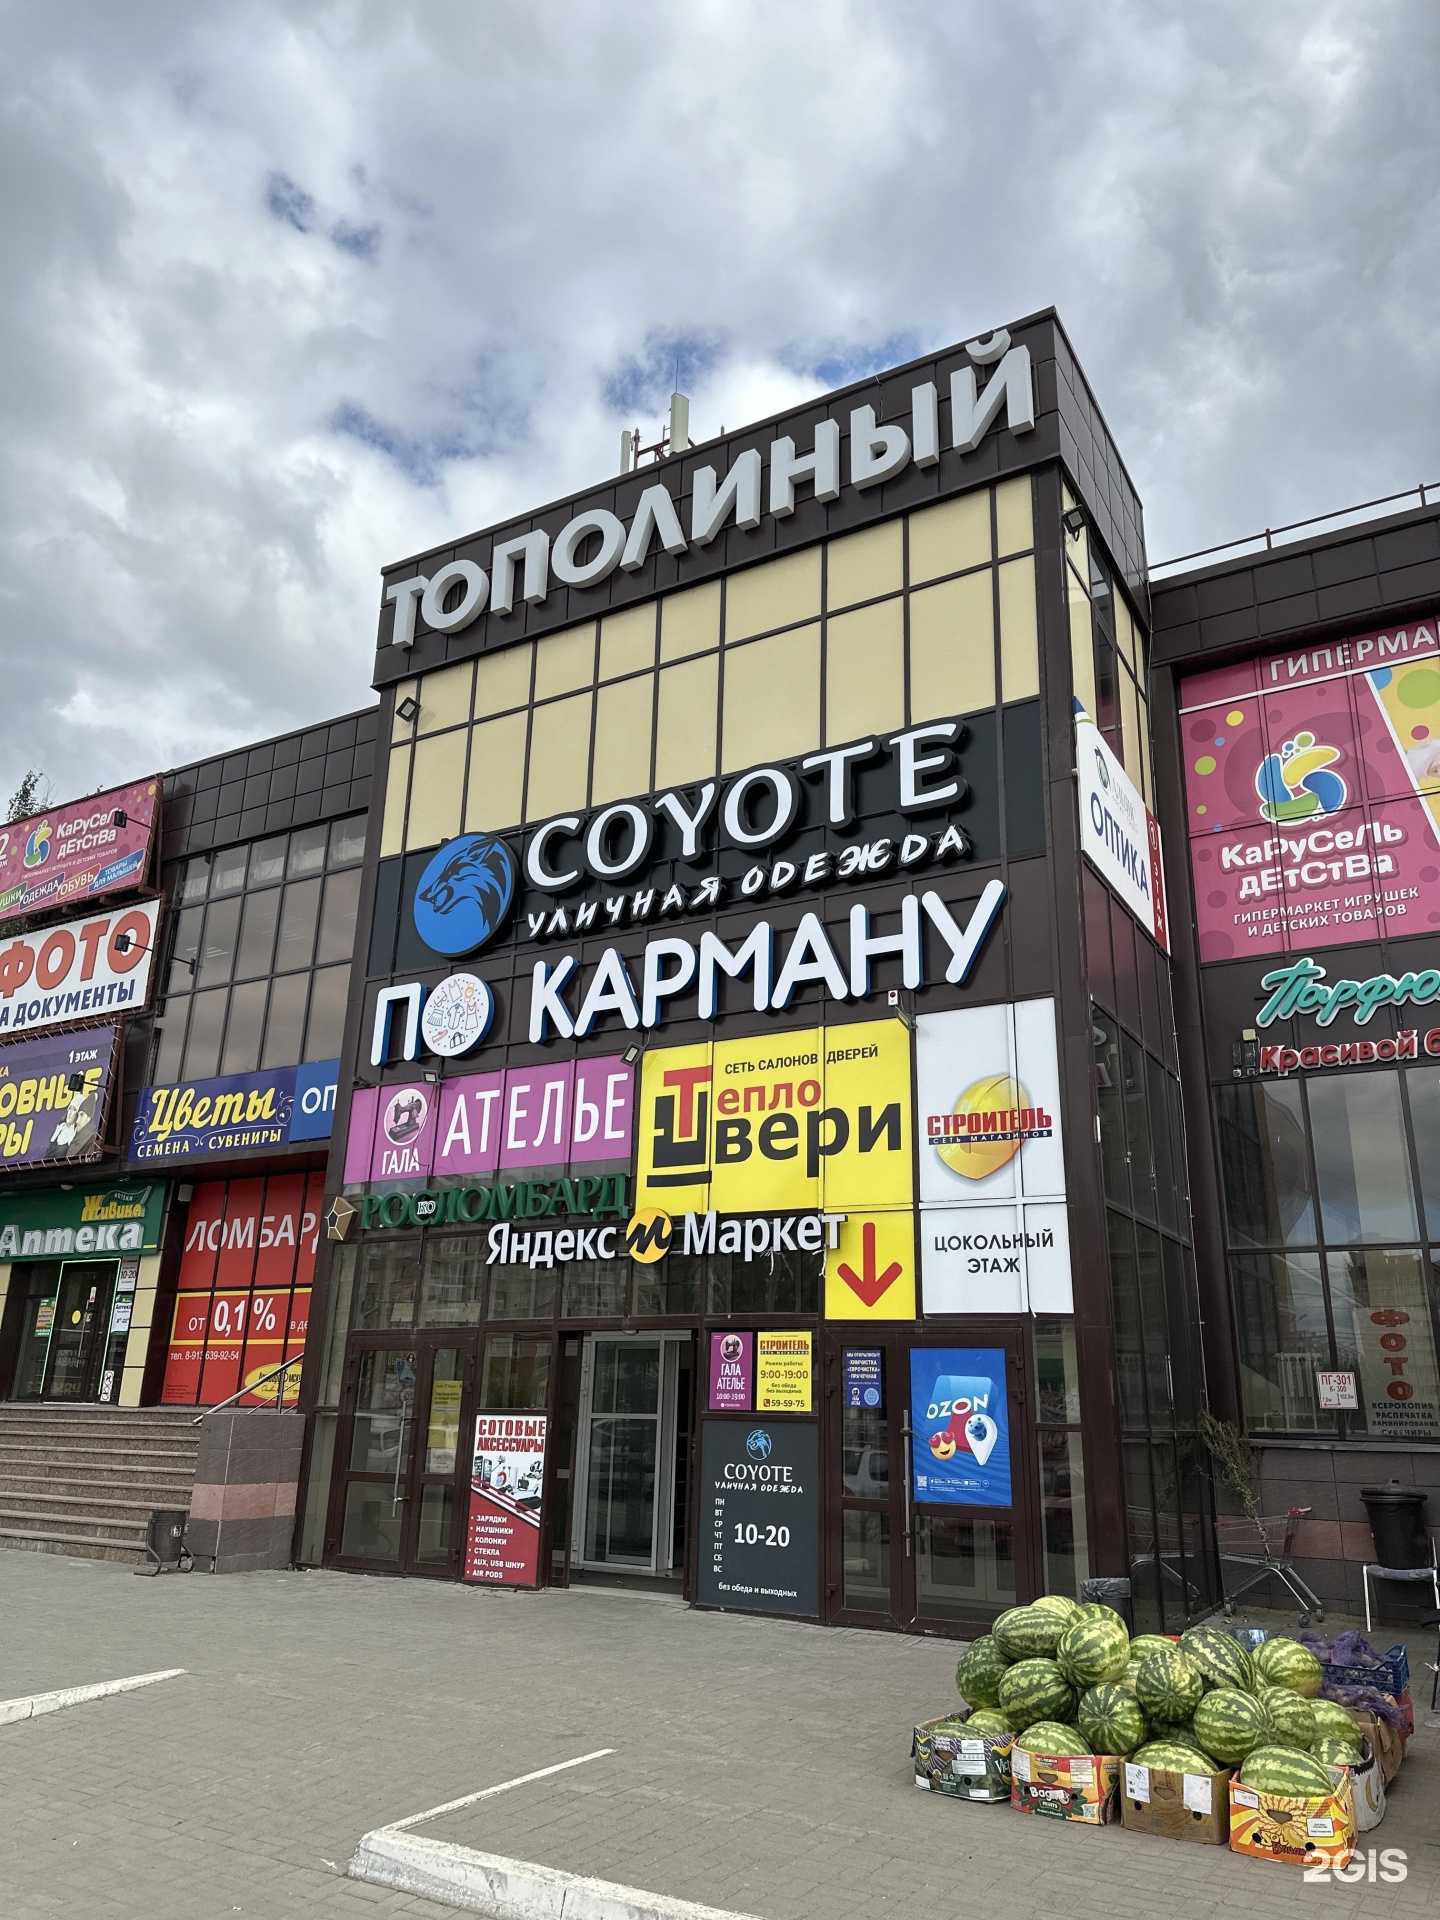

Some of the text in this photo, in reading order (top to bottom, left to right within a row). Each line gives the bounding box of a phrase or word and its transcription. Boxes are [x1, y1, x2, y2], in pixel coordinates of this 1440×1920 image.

[385, 329, 1035, 650] ТОПОЛИНЫЙ
[1270, 621, 1440, 680] ГИПЕРМА
[524, 724, 959, 887] COYOTE
[1091, 792, 1149, 900] ОПТИКА
[22, 880, 59, 905] ОДЕЖДА
[60, 871, 94, 896] ОБУВЬ
[1234, 887, 1420, 924] ГИПЕРМАРКЕТ ИГРУШЕК
[1248, 903, 1408, 937] И ДЕТСКИХ ТОВАРОВ
[0, 911, 151, 998] ФОТО
[528, 878, 1007, 1045] КАРМАНУ
[13, 979, 135, 1028] ДОКУМЕНТЫ
[75, 1049, 98, 1063] ЭТАЖ
[725, 1044, 879, 1075] СЕТЬ САЛОНОВ ДВЕРЕЙ
[1259, 1029, 1418, 1077] Красивой
[149, 1087, 278, 1142] Цветы
[441, 1072, 629, 1157] АТЕЛЬЕ
[927, 1107, 1053, 1137] СТРОИТЕЛЬ
[136, 1128, 282, 1158] СЕМЕНА СУВЕНИРЫ
[932, 1130, 1048, 1144] СЕТЬ МАГАЗИНОВ
[381, 1147, 420, 1176] ГАЛА
[0, 1221, 144, 1256] Аптека
[186, 1212, 319, 1253] ЛОМБАР
[485, 1223, 617, 1269] Яндекс
[683, 1209, 848, 1263] Маркет
[934, 1228, 1054, 1252] ЦОКОЛЬНЫЙ
[967, 1257, 1021, 1274] ЭТАЖ
[760, 1340, 810, 1350] СТРОИТЕЛЬ
[720, 1363, 742, 1376] ГАЛА
[760, 1370, 809, 1379] 9:00-19:00
[717, 1377, 745, 1390] АТЕЛЬЕ
[771, 1399, 805, 1408] 59-59-75
[926, 1393, 989, 1419] OZON
[479, 1419, 546, 1437] СОТОВЫЕ
[476, 1437, 545, 1453] АКСЕССУАРЫ
[724, 1463, 793, 1482] COYOTE
[476, 1515, 507, 1524] ЗАРЯДКИ
[476, 1525, 514, 1535] НАУШНИКИ
[475, 1536, 507, 1546] КОЛОНКИ
[734, 1523, 790, 1548] 10-20
[474, 1547, 500, 1556] СТЕКЛА
[472, 1569, 503, 1579] AIR PODS
[718, 1582, 798, 1598] без обеда и выходных
